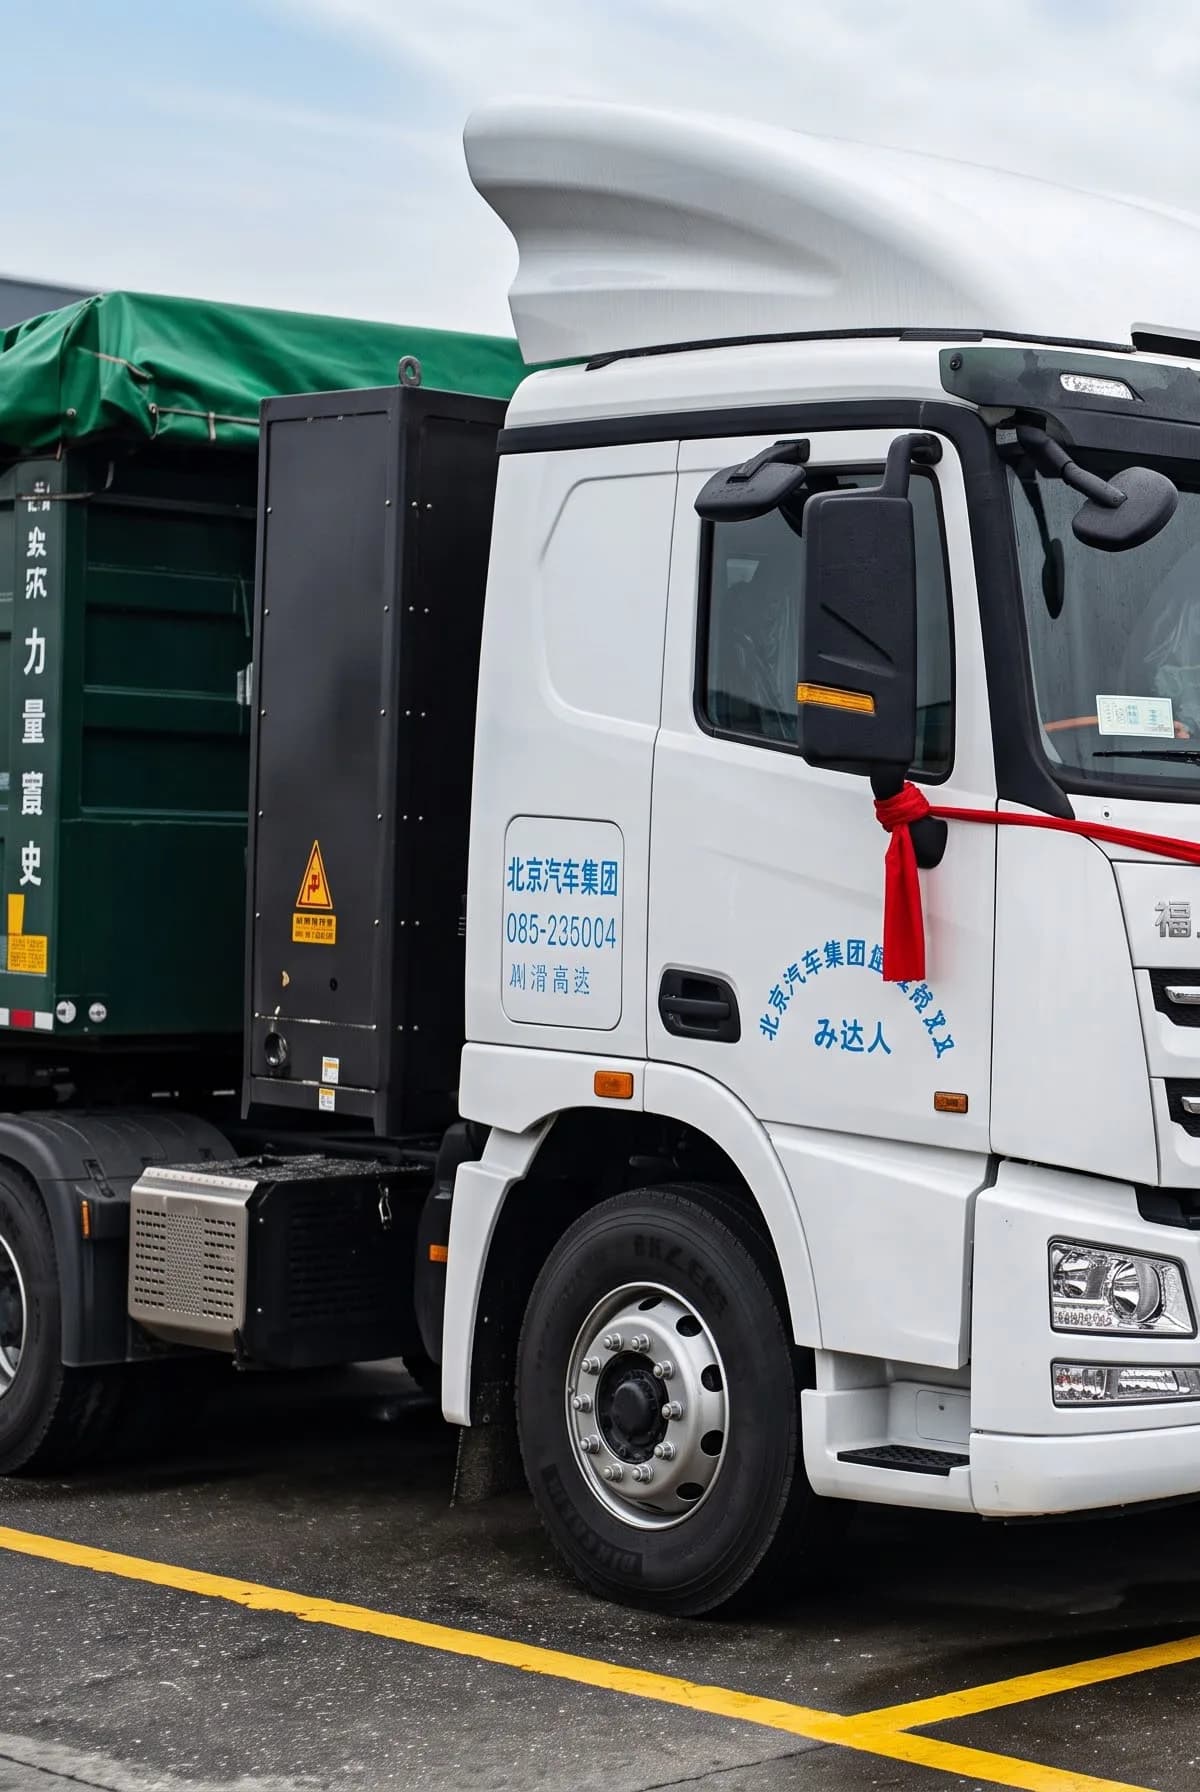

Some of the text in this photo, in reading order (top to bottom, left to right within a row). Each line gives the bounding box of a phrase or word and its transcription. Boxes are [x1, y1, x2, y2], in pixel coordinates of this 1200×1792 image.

[507, 857, 618, 896] 北京汽车集团
[507, 912, 617, 949] 085-235004
